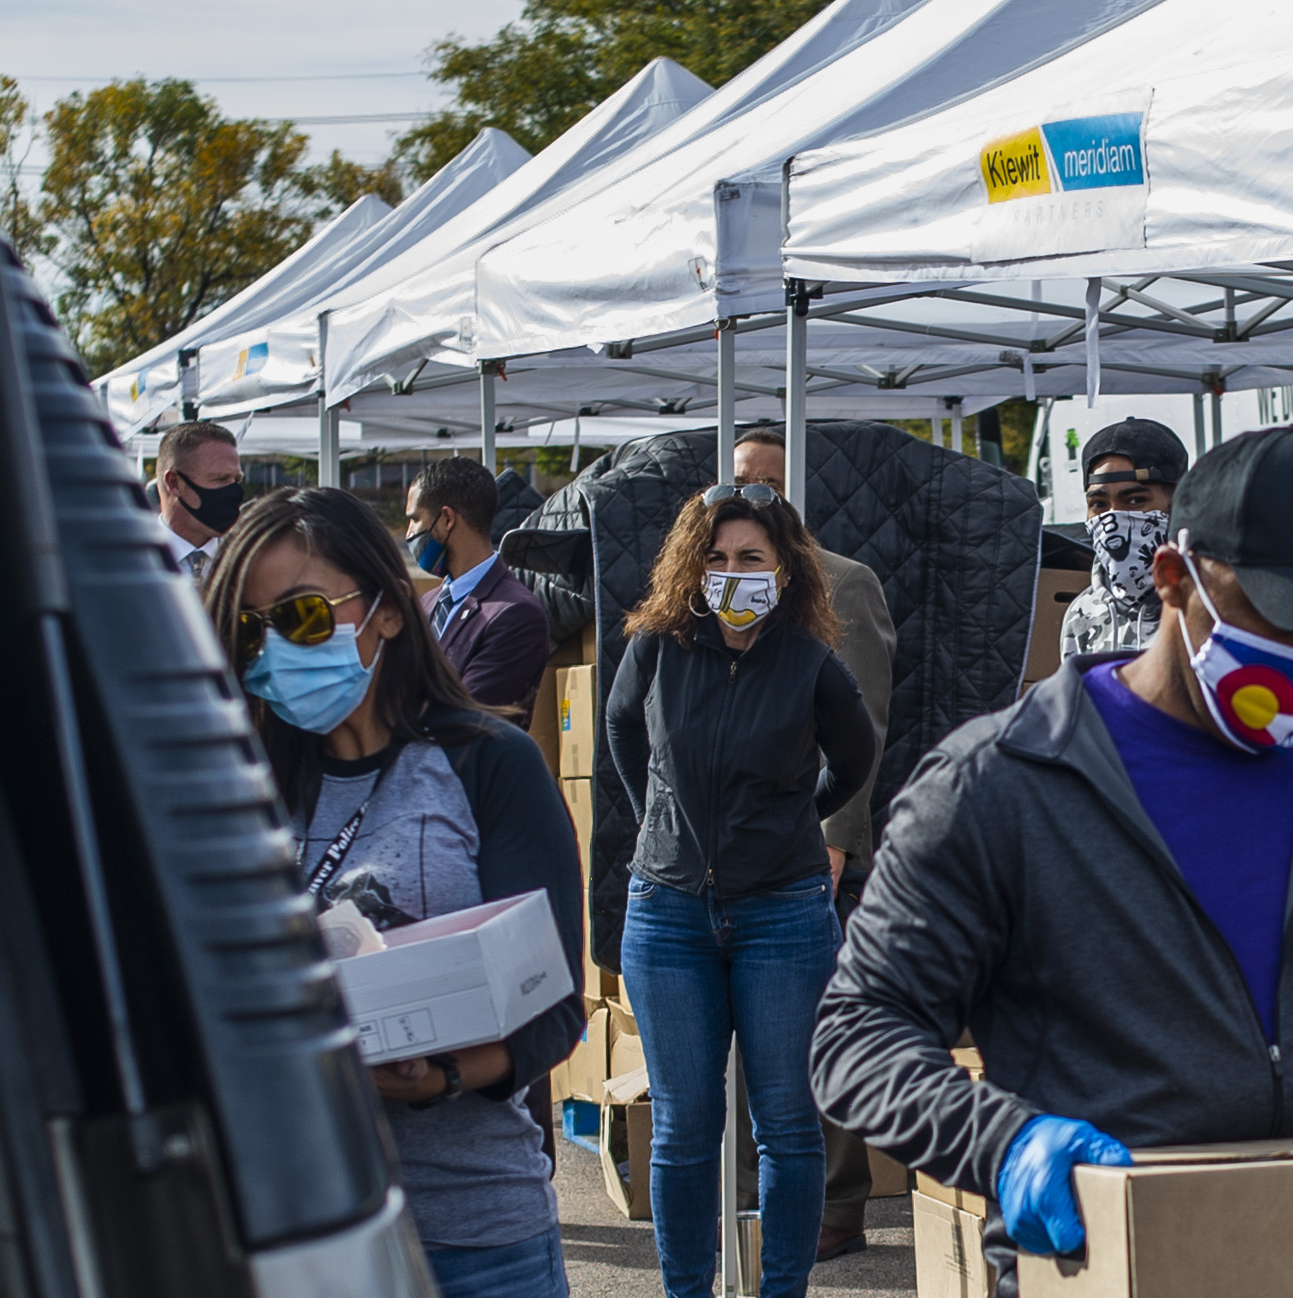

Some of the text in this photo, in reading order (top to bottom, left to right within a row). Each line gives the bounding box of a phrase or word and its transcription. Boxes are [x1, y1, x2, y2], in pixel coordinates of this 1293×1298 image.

[987, 144, 1041, 188] Kiewit
[1063, 138, 1136, 178] meridiam
[1013, 201, 1104, 225] PARTNERS
[327, 816, 360, 861] Police
